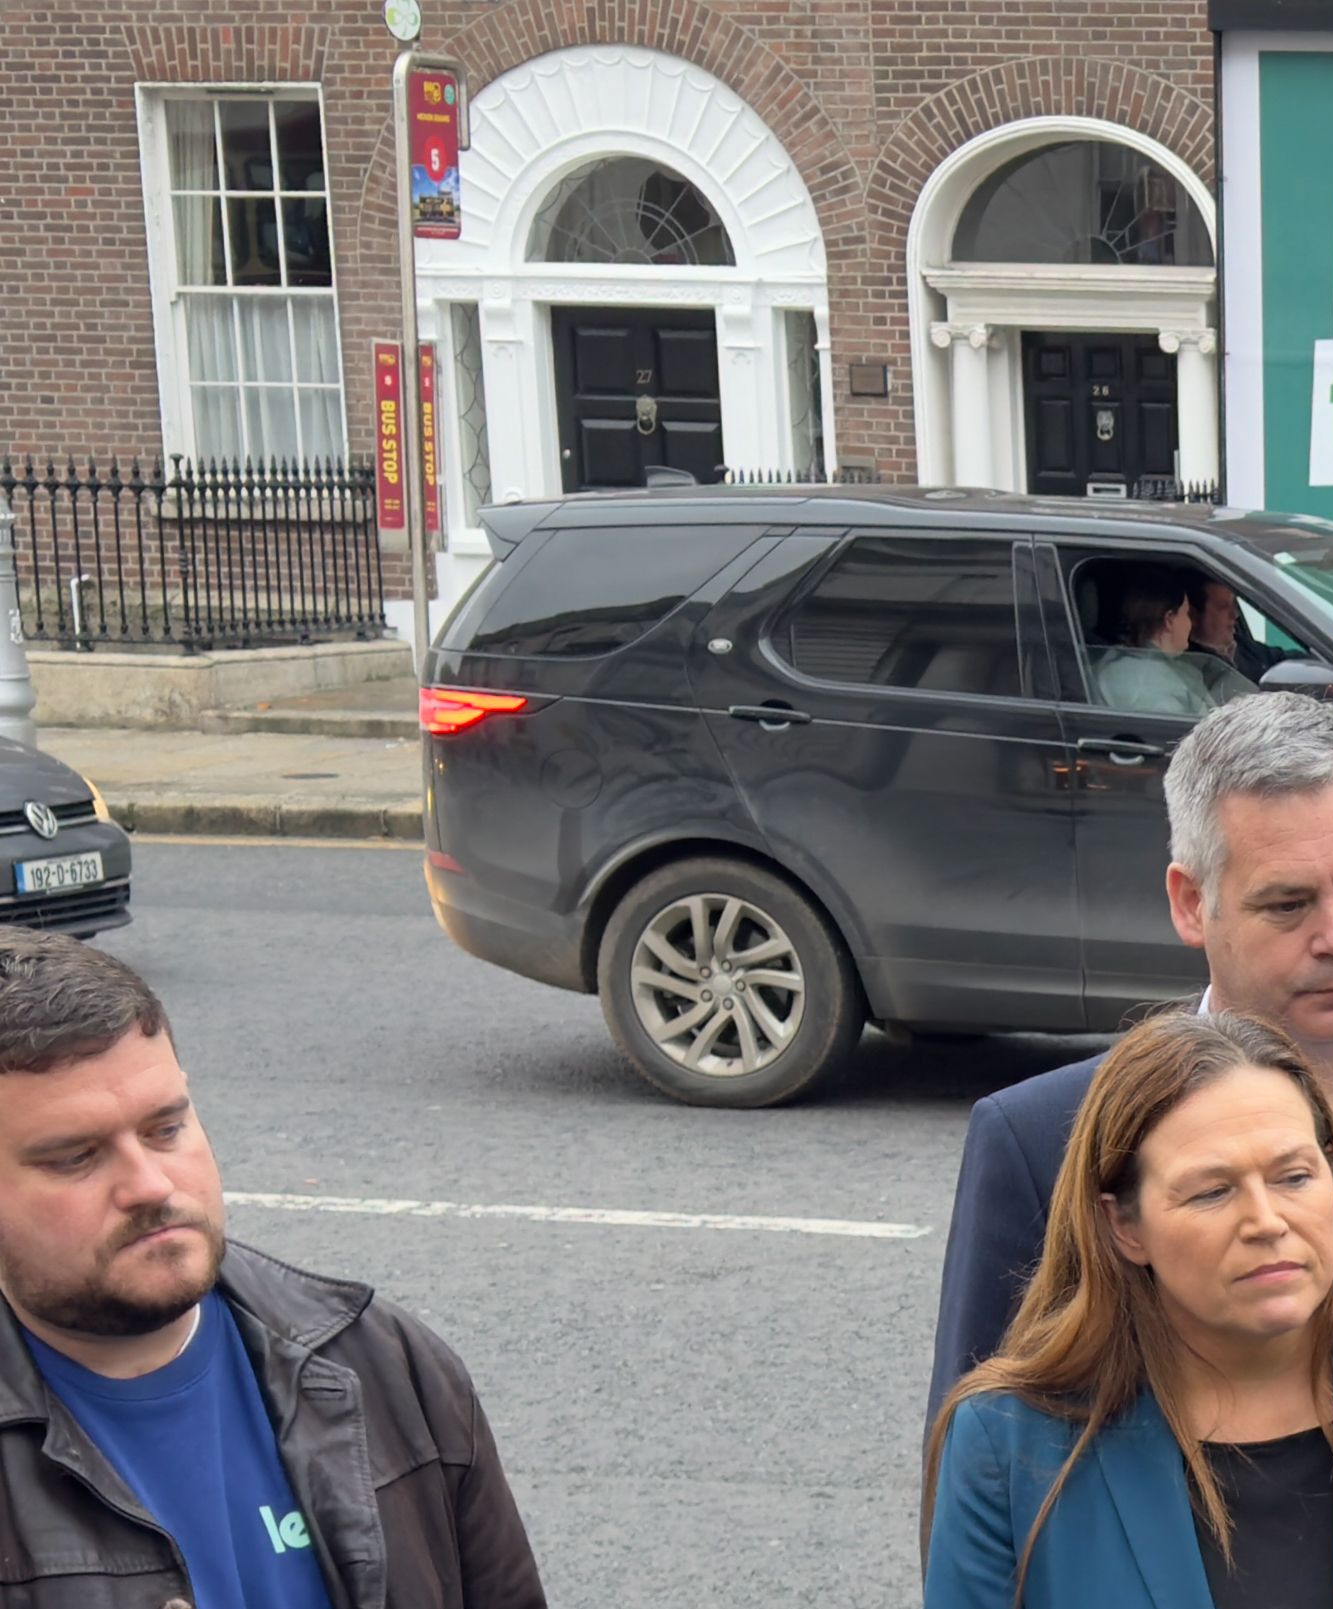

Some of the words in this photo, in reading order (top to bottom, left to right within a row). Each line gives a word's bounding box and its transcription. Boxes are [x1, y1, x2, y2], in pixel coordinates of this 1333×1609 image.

[431, 148, 440, 172] 5
[636, 369, 653, 384] 27
[380, 400, 397, 436] BUS
[422, 402, 433, 437] BUS
[382, 439, 399, 484] STOP
[424, 441, 435, 486] STOP
[31, 859, 98, 889] 192-D-6733
